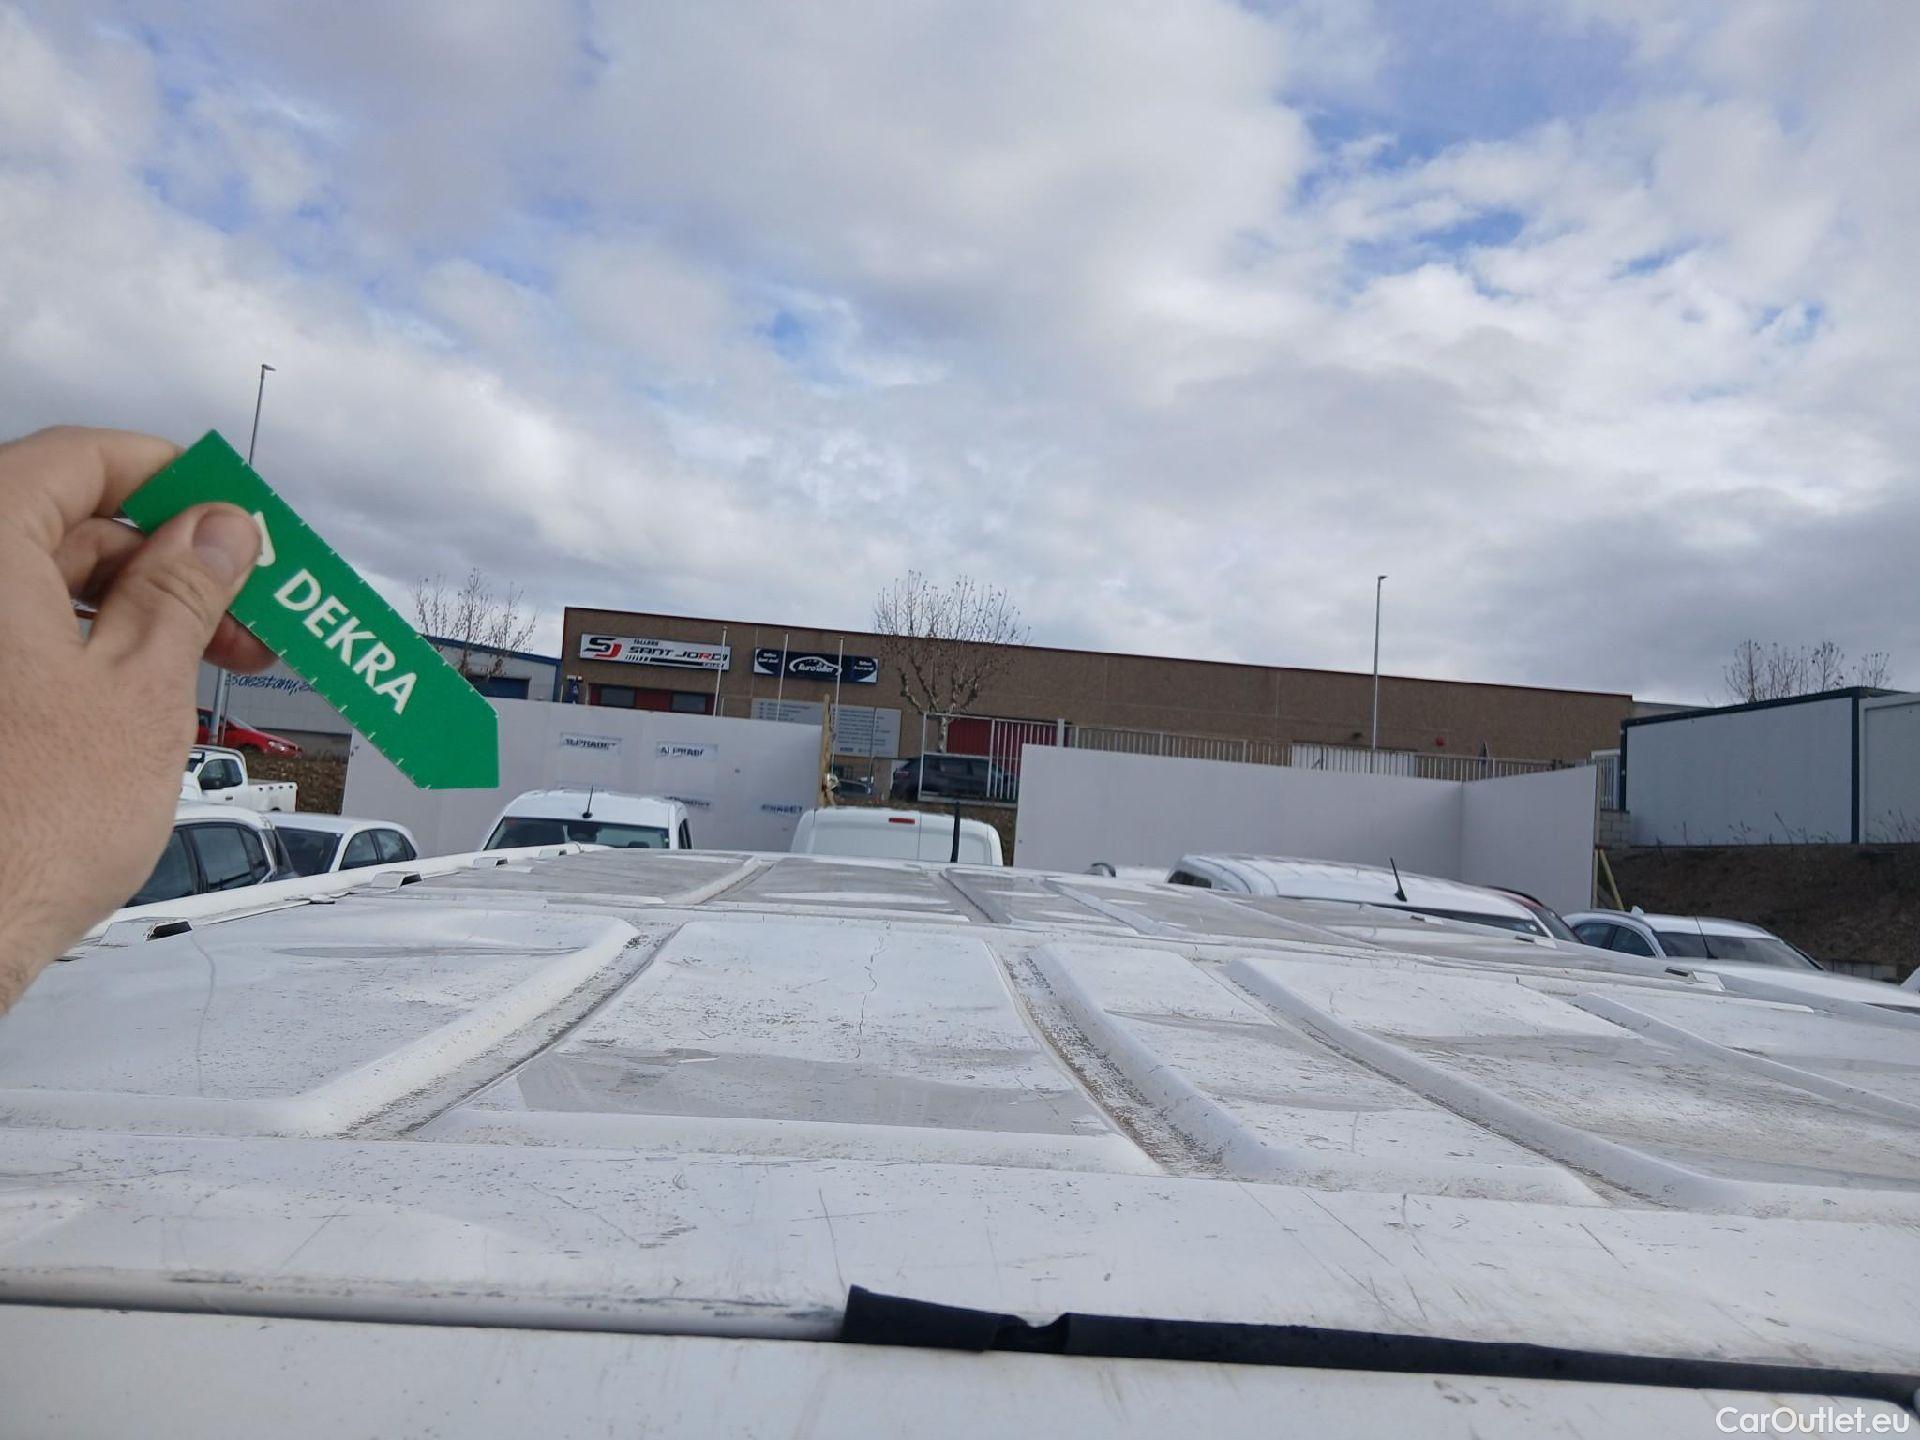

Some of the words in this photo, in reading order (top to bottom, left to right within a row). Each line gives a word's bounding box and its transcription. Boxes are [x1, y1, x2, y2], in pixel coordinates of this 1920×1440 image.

[274, 568, 417, 714] DEKRA
[629, 646, 674, 656] SANT
[675, 650, 728, 662] JORDI
